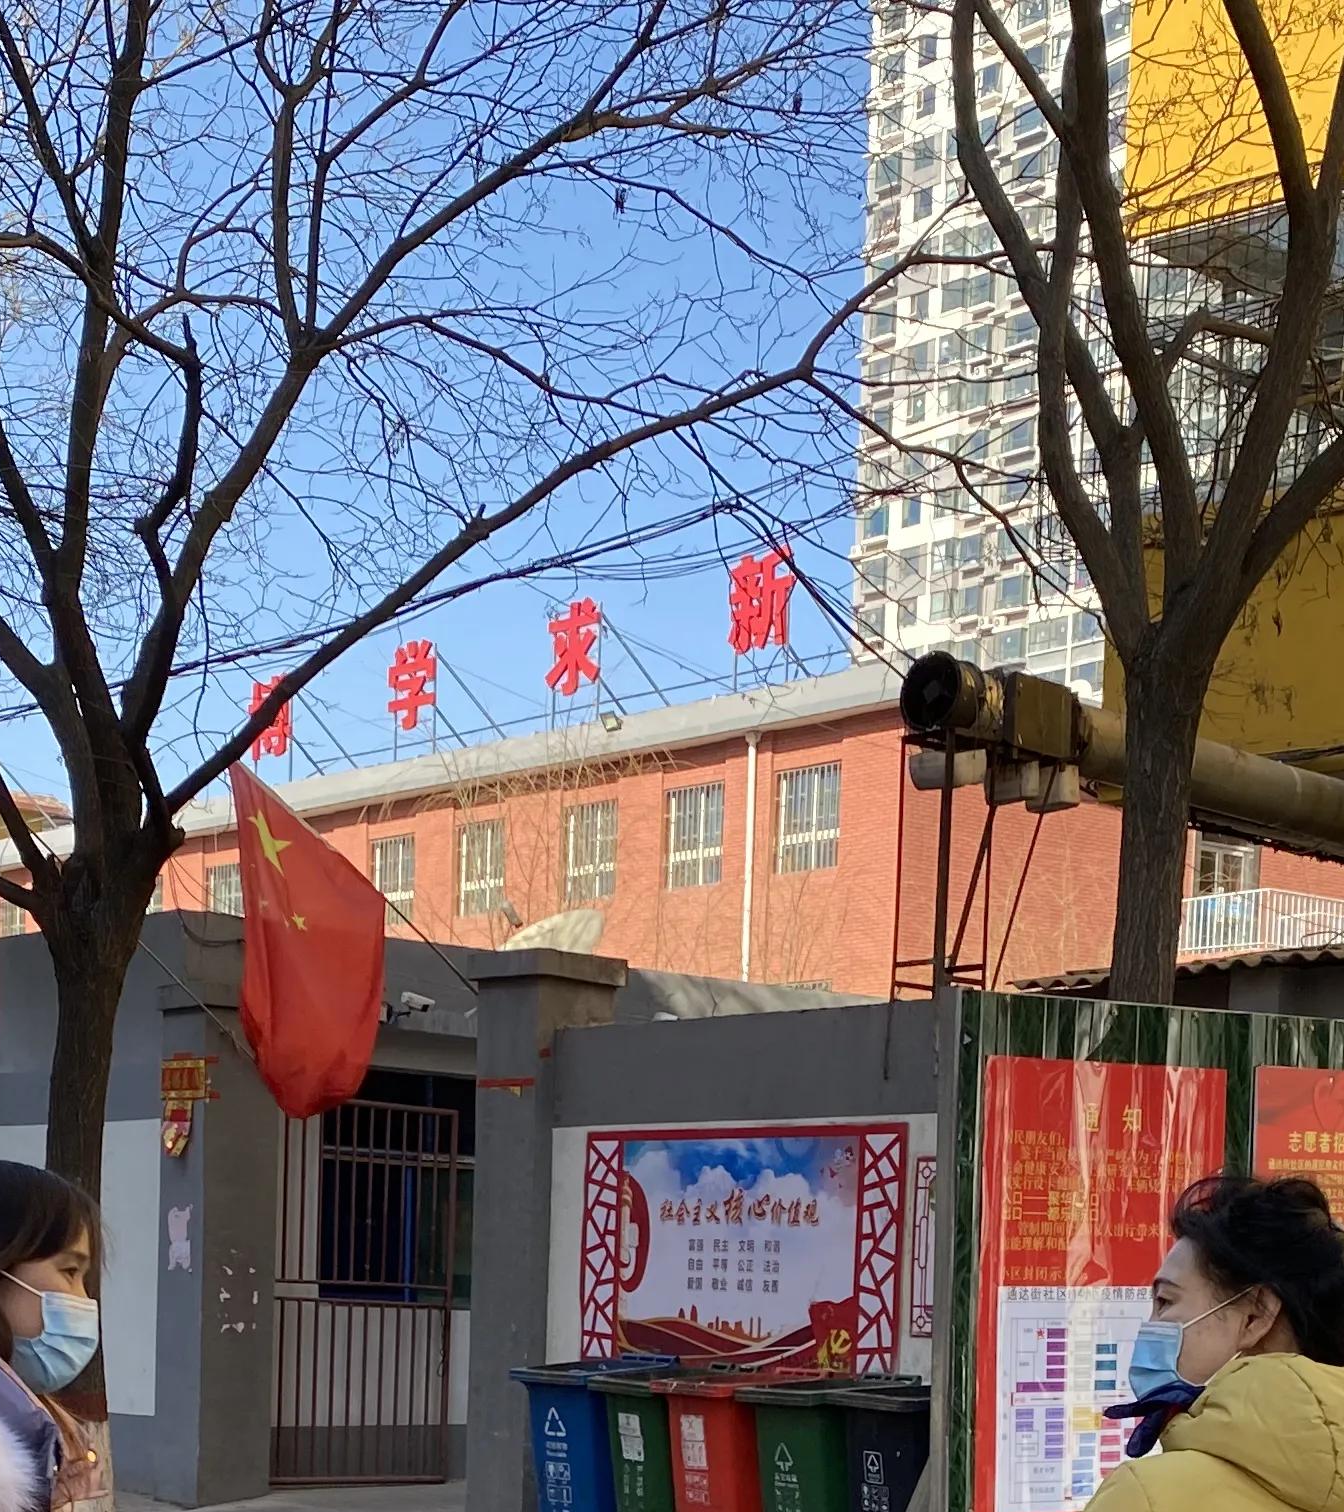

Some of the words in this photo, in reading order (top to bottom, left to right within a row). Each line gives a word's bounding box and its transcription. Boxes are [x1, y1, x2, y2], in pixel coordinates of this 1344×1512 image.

[660, 1188, 820, 1227] 社会主义核心价值观
[713, 1239, 729, 1252] 民主
[738, 1240, 755, 1253] 文明
[688, 1258, 703, 1271] 自由
[712, 1258, 728, 1272] 平等
[737, 1259, 754, 1273] 公正
[763, 1260, 780, 1274] 法治
